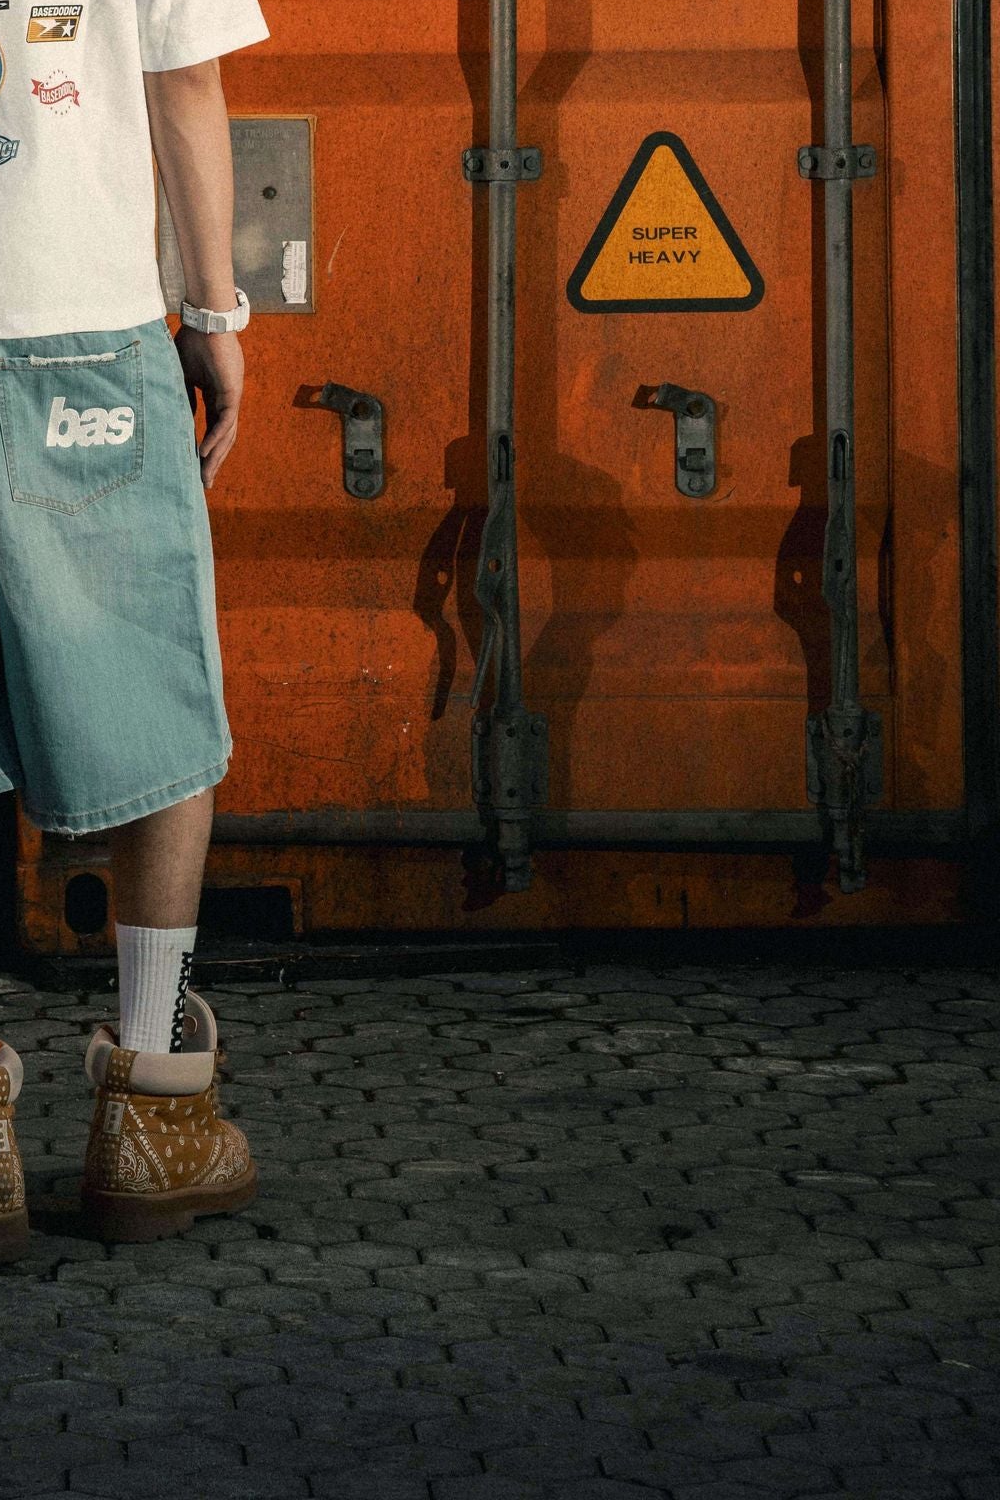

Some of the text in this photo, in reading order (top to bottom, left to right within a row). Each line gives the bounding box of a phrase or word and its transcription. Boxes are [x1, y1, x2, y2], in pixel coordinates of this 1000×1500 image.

[31, 5, 81, 17] BASEDODICI
[40, 81, 76, 103] BASEDODICI
[632, 226, 698, 242] SUPER
[629, 249, 702, 265] HEAVY
[46, 396, 136, 448] bas
